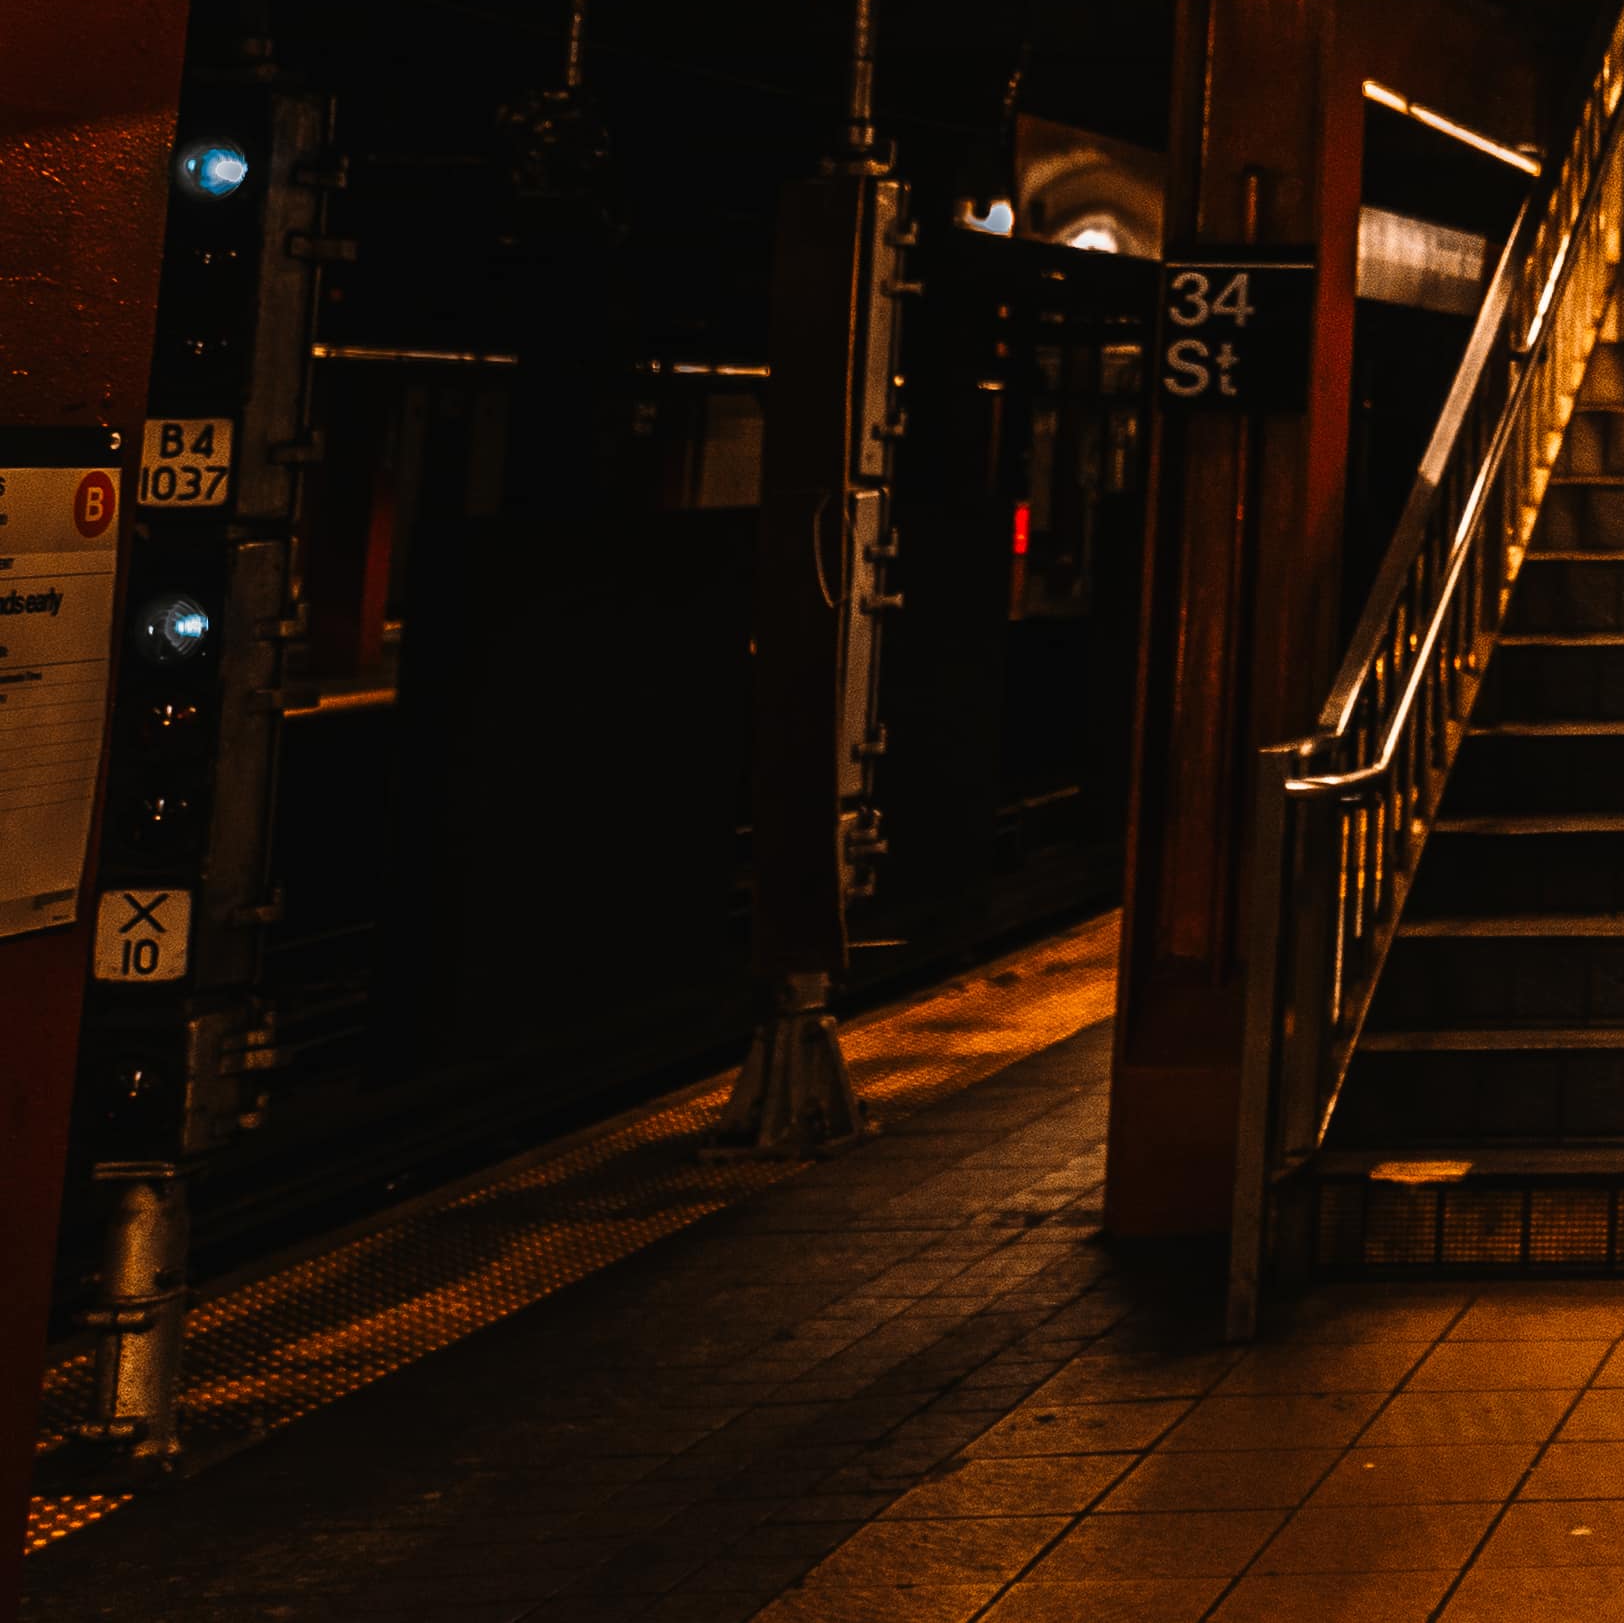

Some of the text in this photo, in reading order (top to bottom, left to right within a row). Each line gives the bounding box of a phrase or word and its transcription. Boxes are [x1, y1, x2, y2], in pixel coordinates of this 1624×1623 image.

[1168, 270, 1255, 327] 34
[1163, 338, 1240, 397] St
[140, 464, 229, 503] 1037
[84, 485, 105, 523] B
[26, 587, 64, 617] early
[121, 939, 160, 976] 10
